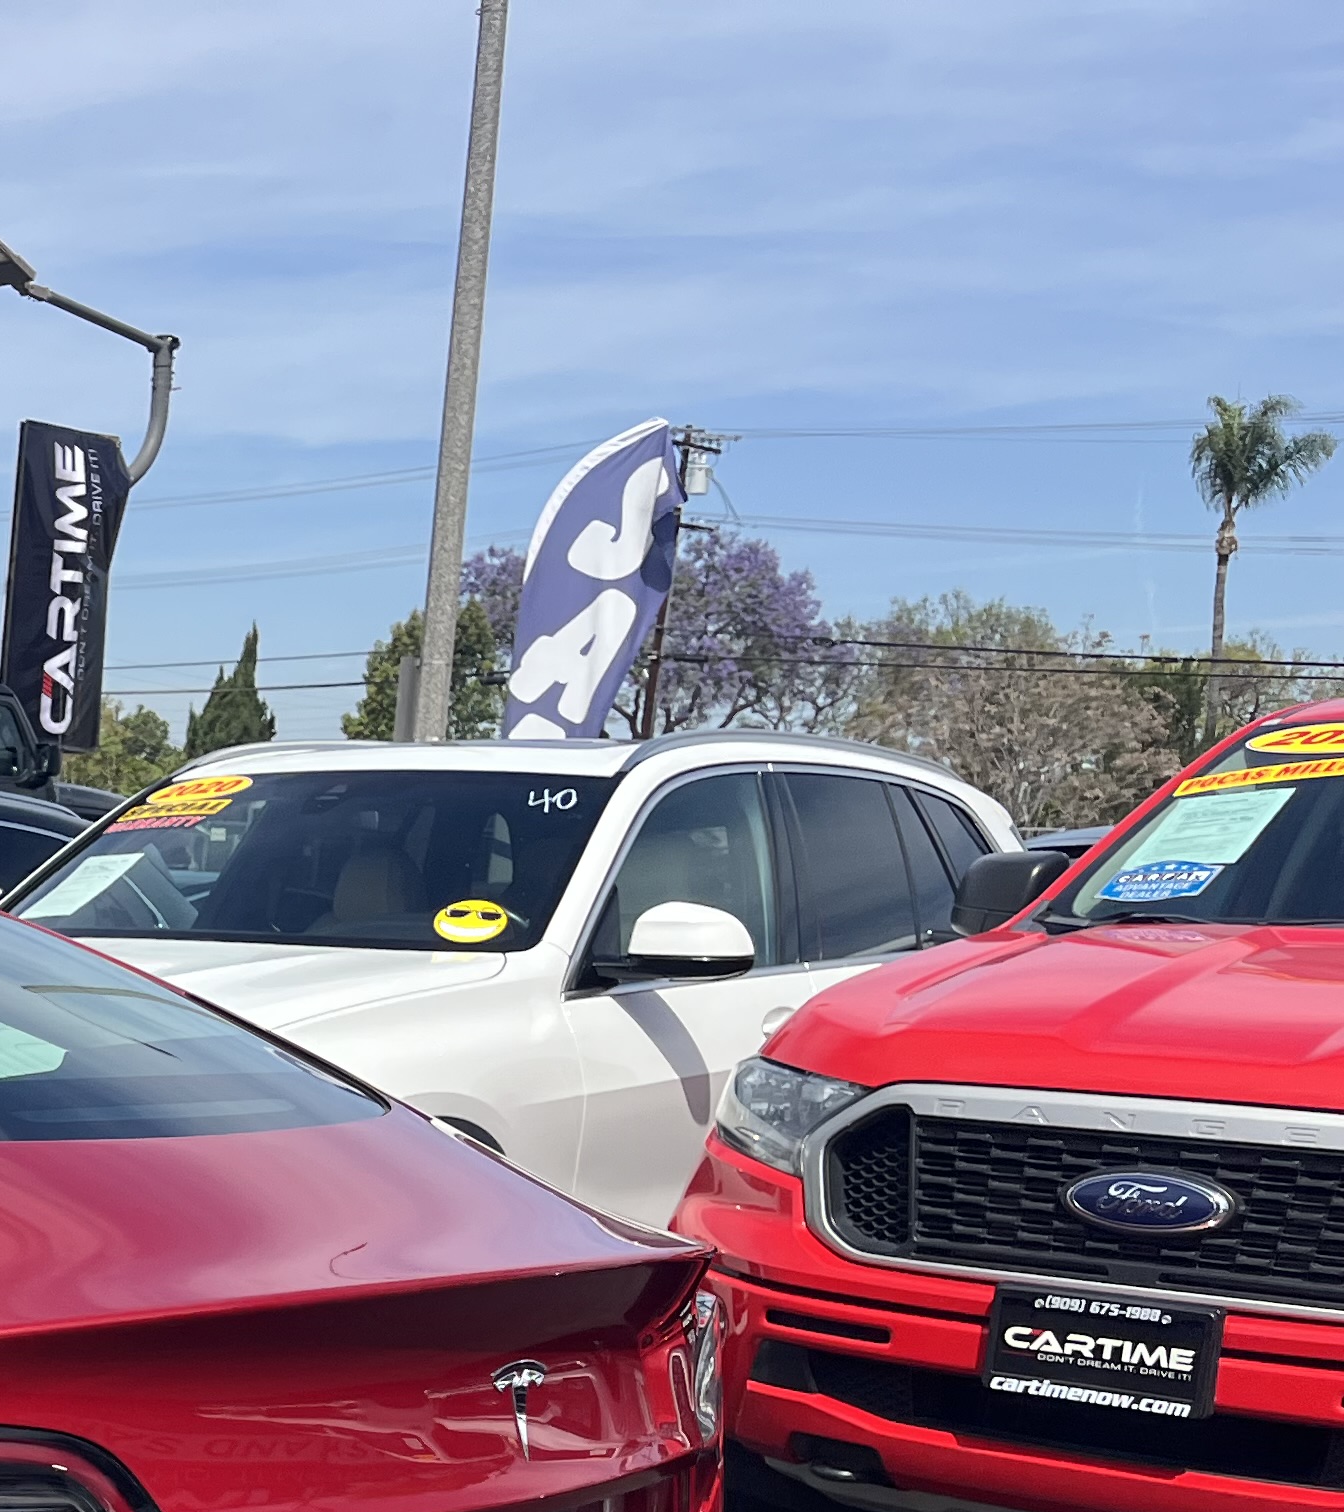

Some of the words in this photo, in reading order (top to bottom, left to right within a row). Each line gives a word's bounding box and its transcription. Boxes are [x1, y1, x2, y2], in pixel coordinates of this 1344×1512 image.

[90, 473, 103, 526] DRIVE
[39, 441, 89, 735] CARTIME
[163, 780, 243, 798] 2020
[1181, 768, 1270, 792] POCAS
[129, 801, 225, 817] SPECIAL
[528, 787, 577, 813] 40
[1114, 882, 1192, 891] ADVANTAGE
[1117, 870, 1211, 883] CARFAX
[1120, 889, 1172, 898] DEALER
[1097, 1180, 1188, 1220] Ford
[1044, 1294, 1085, 1313] (909)
[1004, 1325, 1196, 1372] CARTIME
[1037, 1352, 1074, 1365] DON'T
[1077, 1358, 1121, 1372] DREAM
[1139, 1367, 1175, 1380] DRIVE
[989, 1376, 1191, 1418] cartimenow.com
